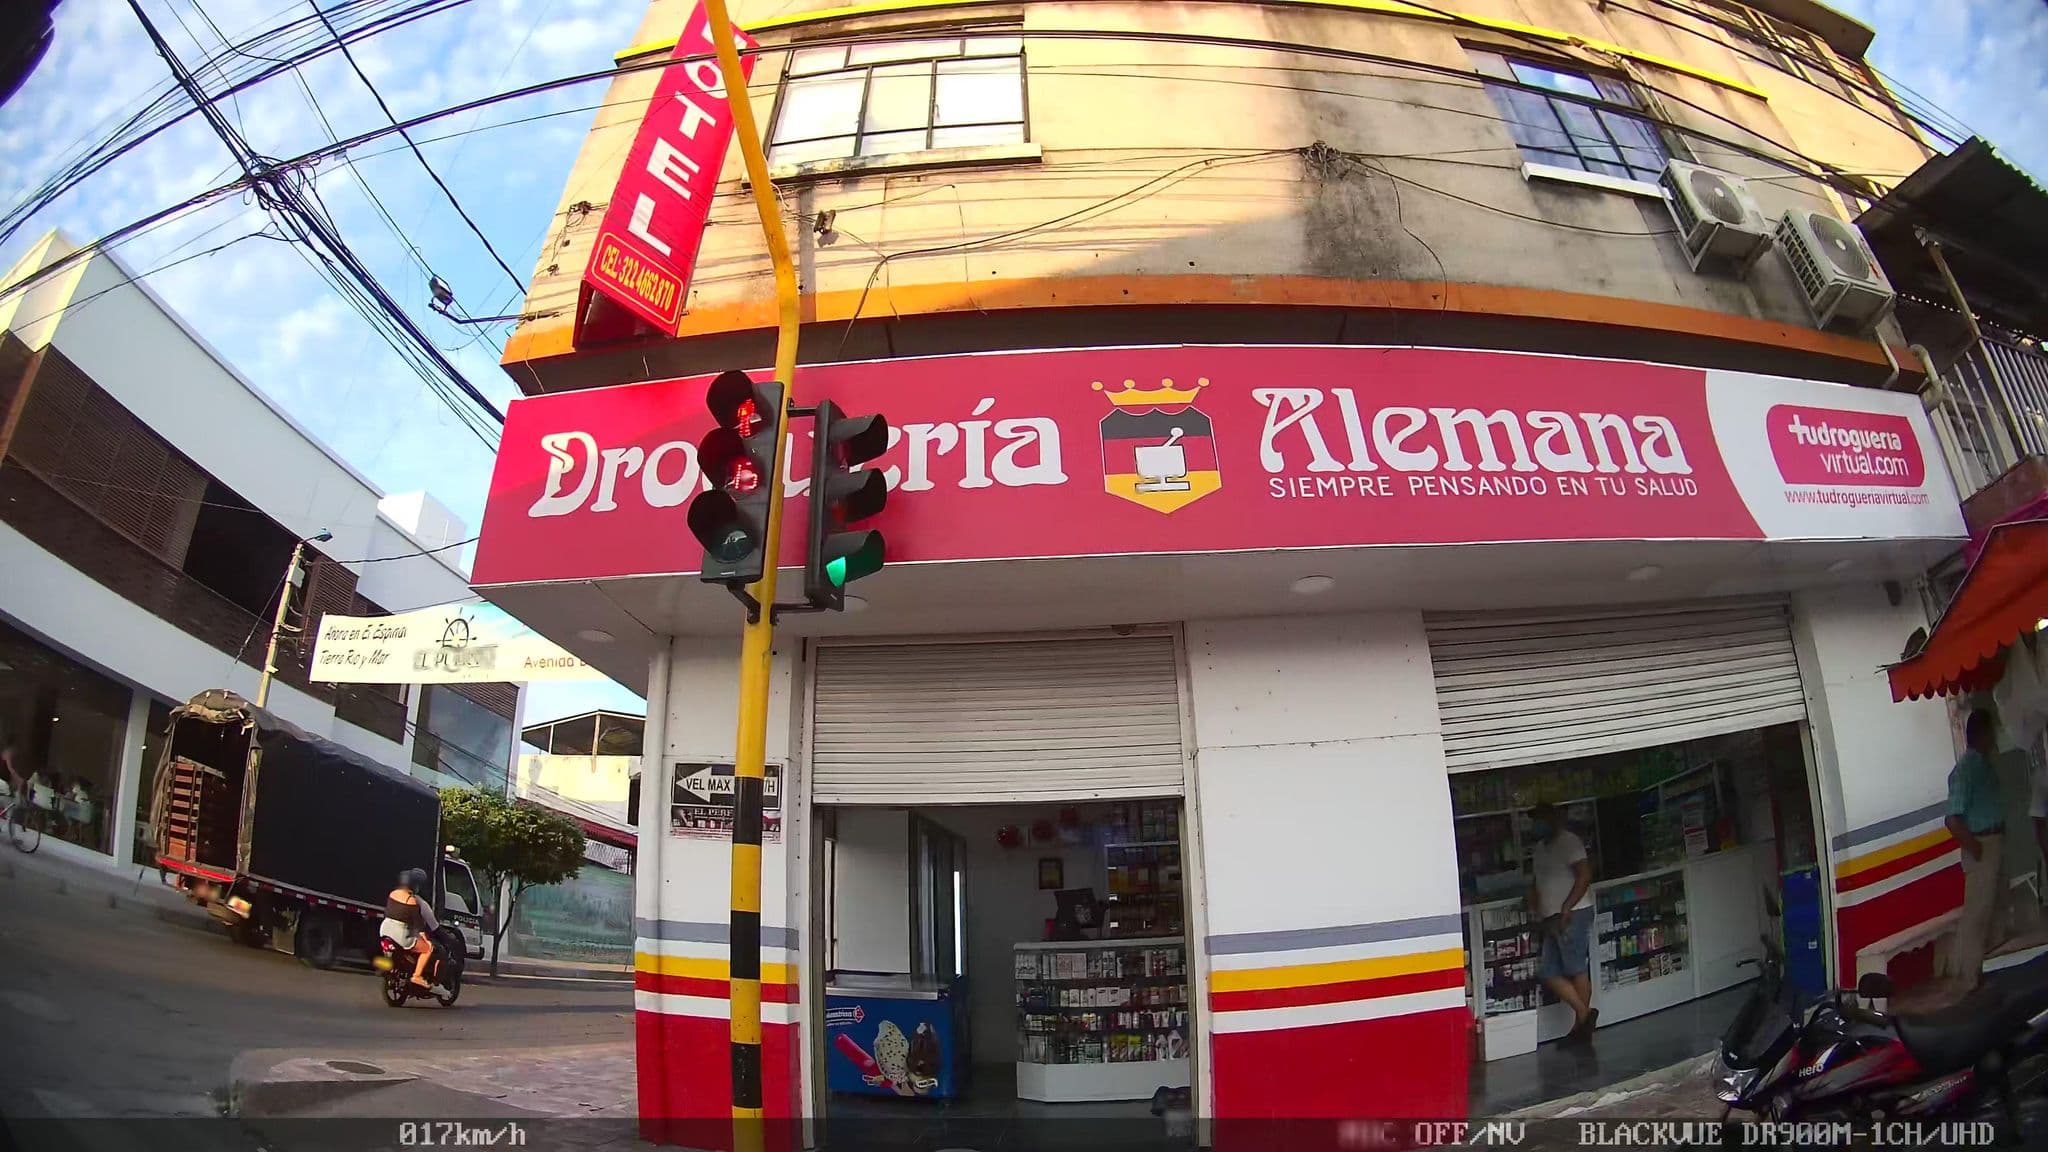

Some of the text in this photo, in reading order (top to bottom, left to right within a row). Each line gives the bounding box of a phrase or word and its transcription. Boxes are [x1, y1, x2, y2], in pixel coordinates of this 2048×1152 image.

[1252, 387, 1694, 475] Alemana
[528, 397, 1068, 517] Droría
[1820, 452, 1910, 477] virtual.com
[1269, 475, 1698, 499] SIEMPRE PENSANDO EN TU SALUD
[1784, 488, 1930, 509] www.tudrogueriavirtual.com
[348, 629, 360, 641] en
[359, 655, 368, 670] y
[367, 649, 390, 665] Mar
[524, 656, 575, 669] Avenida
[686, 778, 705, 791] VEL
[707, 778, 731, 792] MAX
[694, 807, 707, 816] EL
